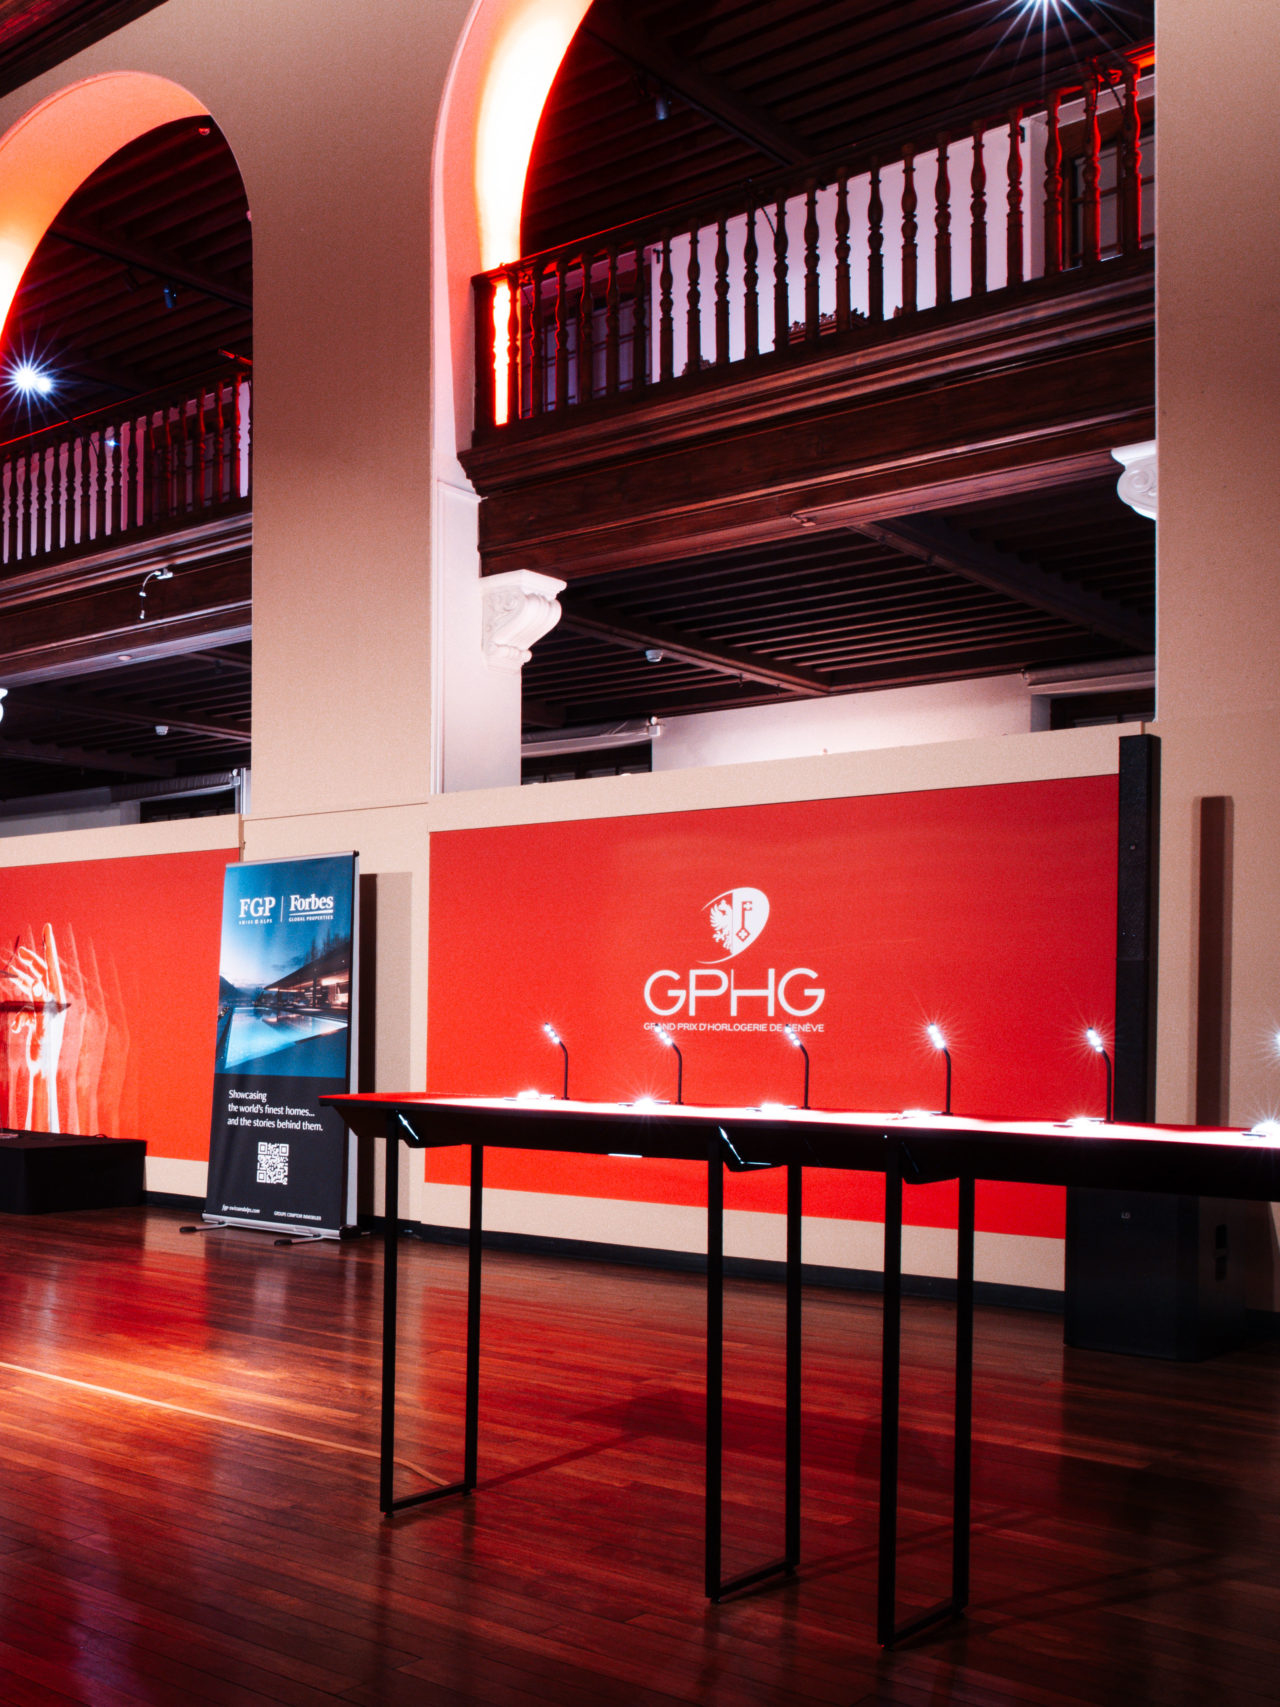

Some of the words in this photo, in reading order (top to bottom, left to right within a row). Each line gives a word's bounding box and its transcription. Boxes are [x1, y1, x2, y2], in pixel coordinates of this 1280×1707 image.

[238, 896, 276, 917] FGP
[289, 893, 334, 911] Forbes
[643, 967, 826, 1017] GPHG
[677, 1022, 697, 1031] PRIX
[769, 1023, 783, 1032] DE
[784, 1022, 825, 1033] ENÈVE
[228, 1089, 267, 1103] Showcasing
[228, 1103, 239, 1112] the
[239, 1104, 263, 1114] world's
[265, 1105, 284, 1115] finest
[285, 1106, 315, 1117] homes...
[227, 1117, 239, 1126] and
[240, 1117, 251, 1127] the
[253, 1118, 275, 1128] stories
[277, 1119, 301, 1130] behind
[302, 1120, 323, 1132] them.
